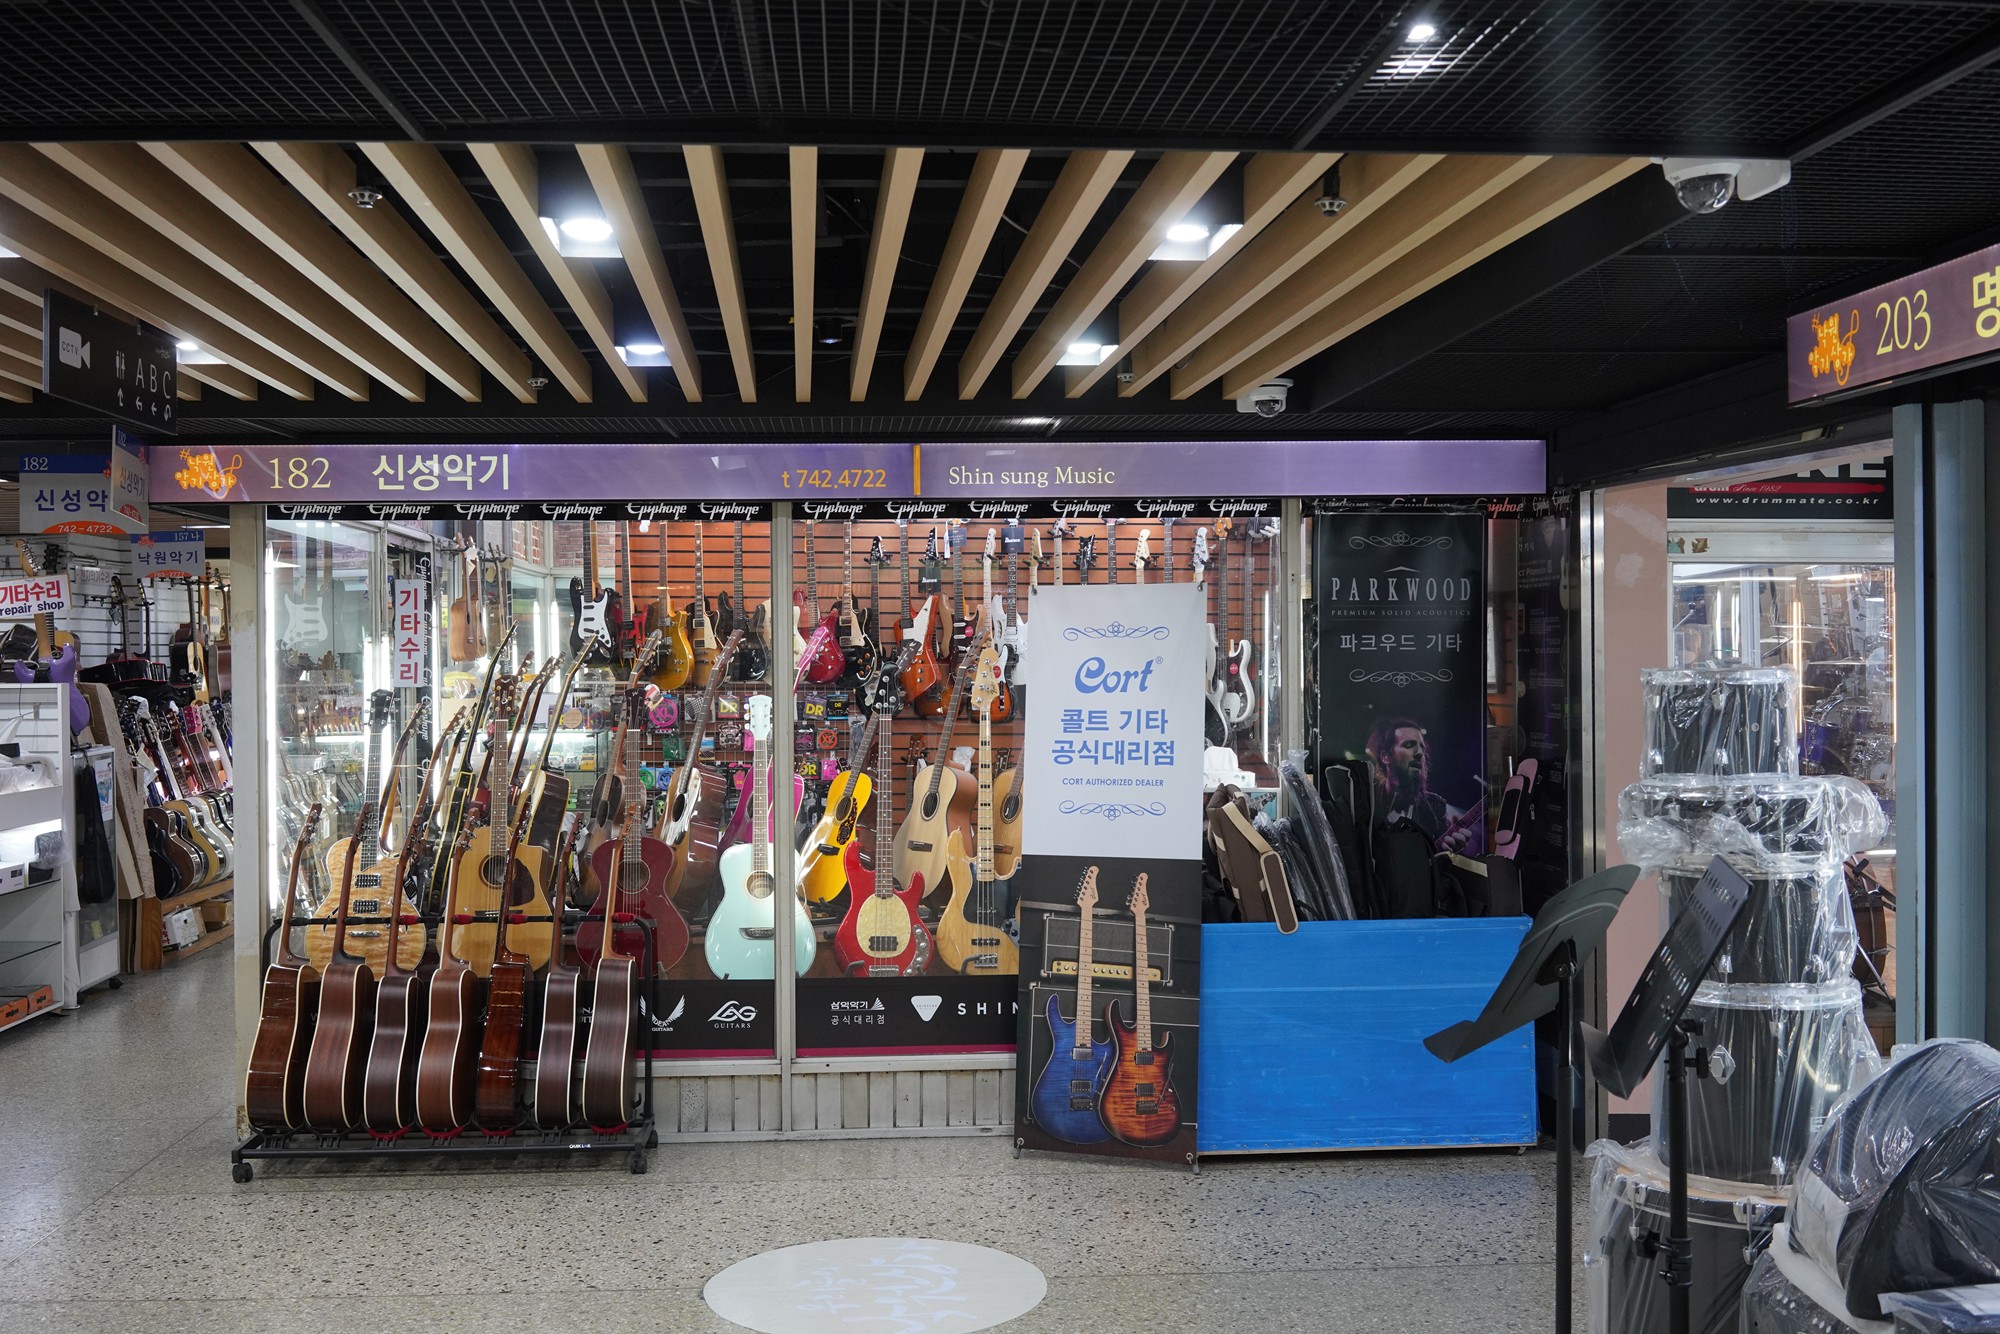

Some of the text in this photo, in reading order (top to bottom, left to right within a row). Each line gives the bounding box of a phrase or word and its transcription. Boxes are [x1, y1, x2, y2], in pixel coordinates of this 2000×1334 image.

[1875, 289, 1932, 356] 203
[61, 340, 79, 356] CCTV
[1808, 343, 1855, 373] 악기상가
[136, 358, 171, 399] A B C
[23, 457, 48, 471] 182
[269, 457, 331, 489] 182
[372, 454, 509, 491] 신성악기
[120, 466, 146, 500] 신성악기
[176, 470, 235, 487] 악기상가
[781, 469, 886, 490] t 742.4722
[949, 466, 1116, 488] Shin sung Music
[1758, 485, 1782, 493] 1982
[34, 489, 108, 512] 신성악
[801, 498, 1268, 519] Epiphone Epiphone Epiphone Epiphone Epiphone Epiphone
[1695, 497, 1880, 505] www.drummate.co.kr
[278, 502, 759, 520] Epiphone Epiphone Epiphone Epiphone Epiphone Epiphone
[58, 525, 112, 533] 742-4722
[174, 532, 188, 541] 157
[138, 551, 198, 565] 낙원악기
[0, 580, 61, 605] 기타수리
[1331, 577, 1471, 601] PARKWOOD
[37, 600, 65, 611] shop
[399, 588, 420, 684] 기타수리
[1340, 633, 1462, 653] 파크우드 기타
[1074, 656, 1154, 694] Cort
[719, 702, 738, 713] DR
[805, 703, 824, 716] DR
[1061, 708, 1168, 734] 콜트 기타
[1052, 739, 1175, 766] 공식대리점
[1062, 778, 1164, 787] CORT AUTHORIZED DEALER
[714, 1022, 751, 1030] GUITARS
[830, 1014, 885, 1026] 공식대리점
